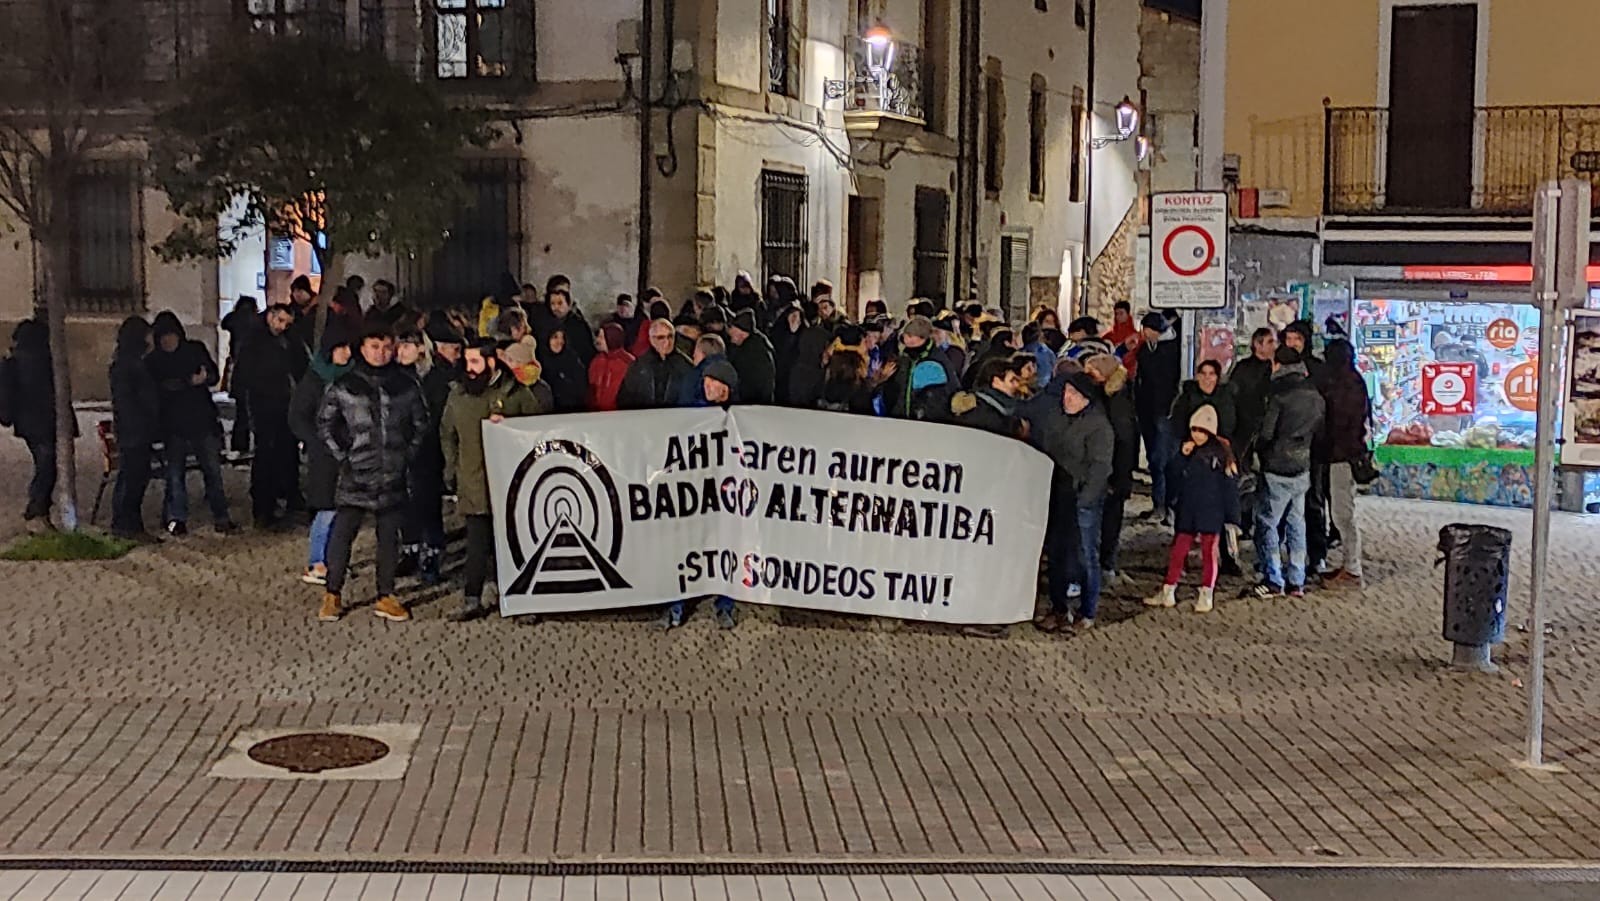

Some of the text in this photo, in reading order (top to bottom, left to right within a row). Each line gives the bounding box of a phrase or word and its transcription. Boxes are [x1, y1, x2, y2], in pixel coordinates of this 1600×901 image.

[1164, 196, 1214, 206] KONTUZ
[1490, 321, 1516, 338] ria
[1510, 366, 1537, 393] ri
[663, 429, 963, 494] AHT-aren aurrean
[628, 475, 993, 546] BADAGO ALTERNATIBA
[677, 549, 738, 594] ¡STOP
[742, 552, 876, 600] SONDEOS
